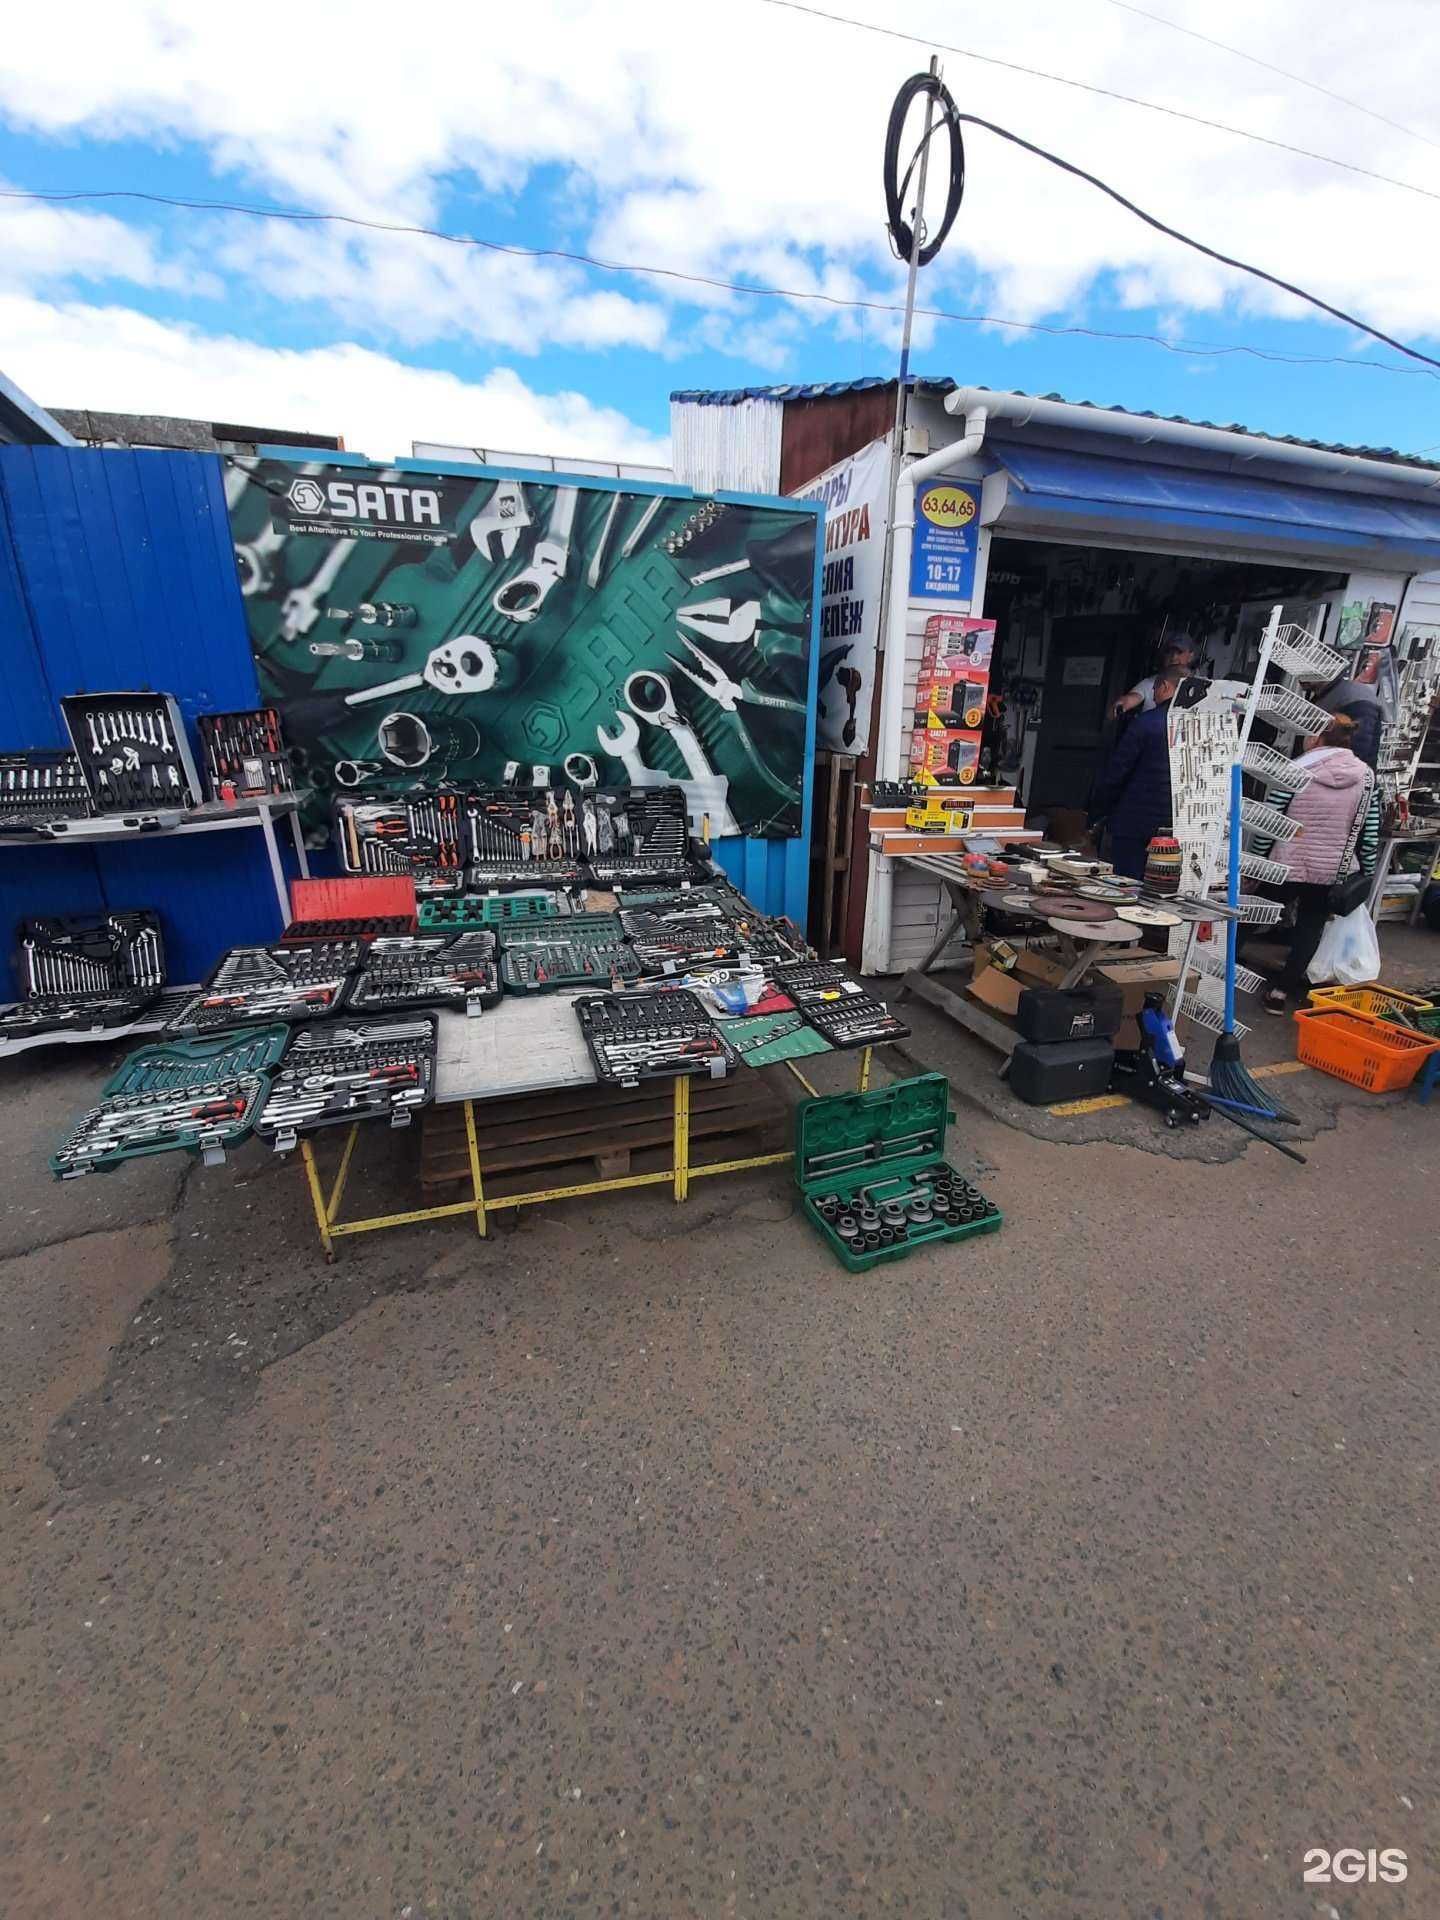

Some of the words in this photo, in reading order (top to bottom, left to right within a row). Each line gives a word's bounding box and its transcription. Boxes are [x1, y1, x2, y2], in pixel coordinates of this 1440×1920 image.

[327, 483, 441, 525] SATA
[923, 497, 974, 517] 63,64,65
[289, 524, 307, 532] Best
[308, 525, 348, 535] Alternative
[349, 528, 359, 536] To
[360, 529, 376, 538] Your
[377, 531, 422, 541] Professional
[825, 503, 870, 554] ИТУРА
[927, 564, 961, 582] 10-17
